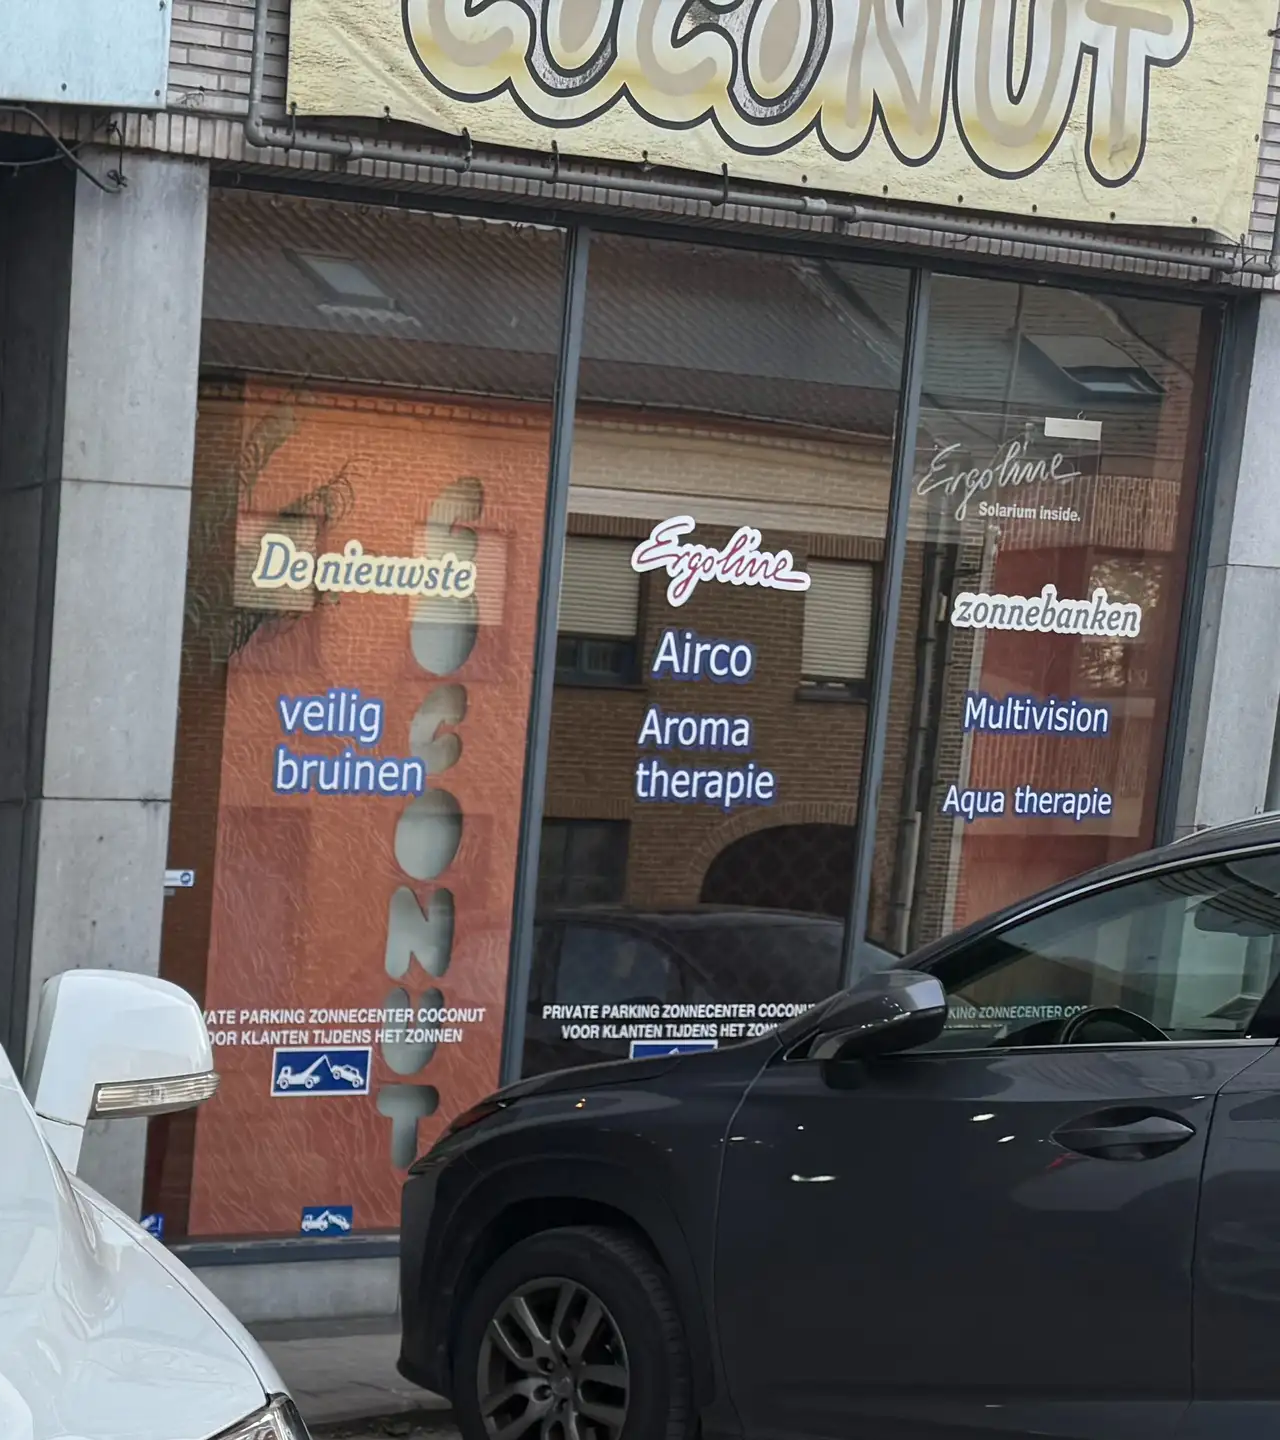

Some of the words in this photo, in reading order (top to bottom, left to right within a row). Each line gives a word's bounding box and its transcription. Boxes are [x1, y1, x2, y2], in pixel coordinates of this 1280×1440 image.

[916, 440, 1082, 521] Ergoline
[978, 501, 1037, 519] Solarium
[1039, 506, 1081, 522] inside.
[258, 541, 308, 583] De
[320, 547, 473, 592] nieuwste
[635, 521, 806, 600] Ergoline
[956, 593, 1138, 632] zonnebanken
[652, 631, 752, 677] Airco
[280, 693, 382, 742] veilig
[638, 708, 750, 746] Aroma
[964, 696, 1109, 732] Multivision
[275, 749, 423, 792] bruinen
[635, 760, 774, 807] therapie
[942, 785, 1005, 819] Aqua
[1014, 785, 1112, 820] therapie
[240, 1009, 305, 1024] PARKING
[308, 1008, 414, 1023] ZONNECENTER
[417, 1007, 486, 1023] COCONUT
[542, 1005, 599, 1019] PRIVATE
[601, 1004, 660, 1019] PARKING
[661, 1004, 755, 1019] ZONNECENTER
[758, 1003, 815, 1018] COCON
[948, 1006, 977, 1019] KING
[978, 1005, 1062, 1019] ZONNECENTER
[208, 1031, 237, 1046] OOR
[241, 1030, 309, 1045] KLANTEN
[313, 1030, 371, 1044] TIJDENS
[375, 1029, 403, 1043] HET
[405, 1028, 463, 1043] ZONNEN
[561, 1024, 600, 1039] VOOR
[602, 1024, 663, 1039] KLANTEN
[665, 1023, 718, 1038] TIJDENS
[719, 1023, 746, 1037] HET
[746, 1022, 778, 1037] ZON
